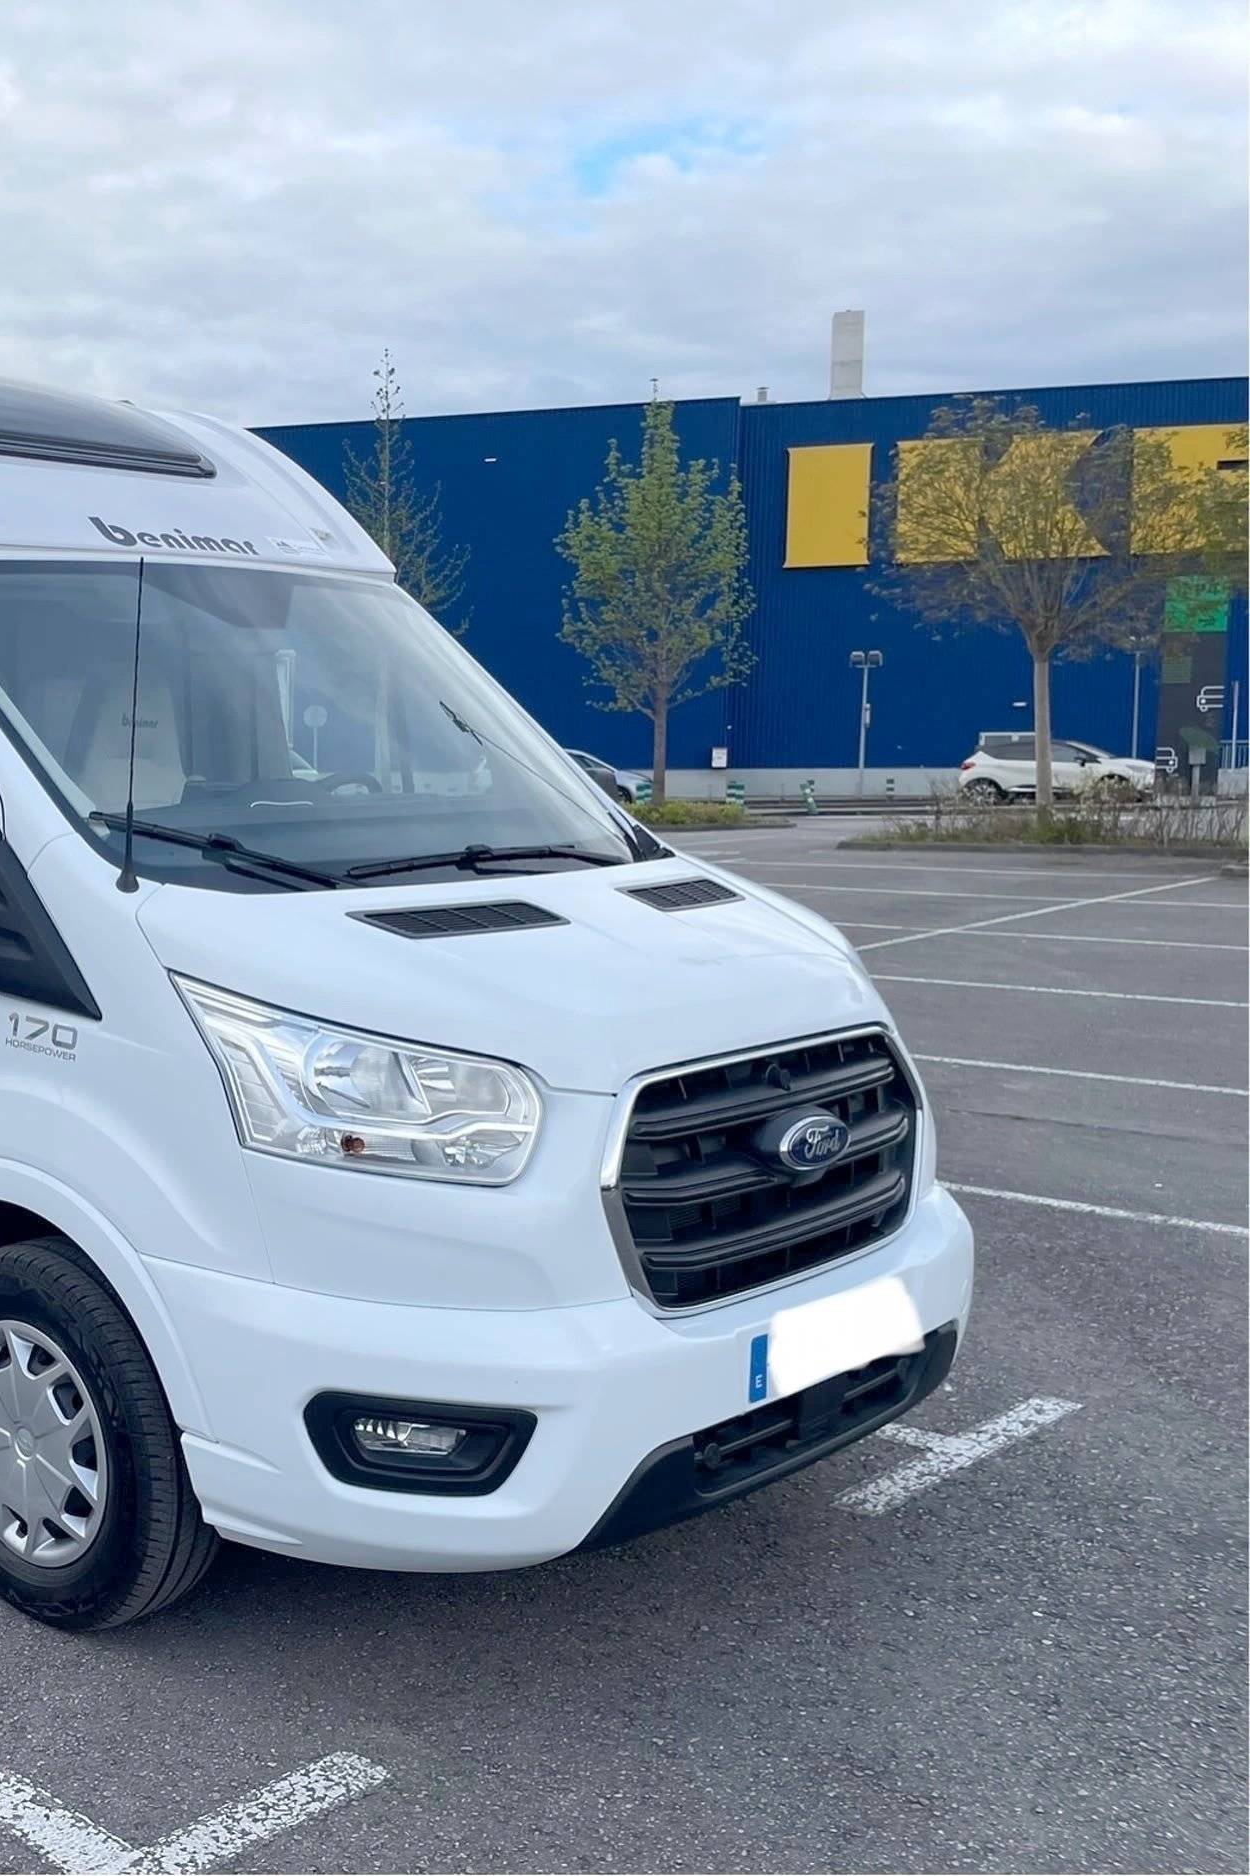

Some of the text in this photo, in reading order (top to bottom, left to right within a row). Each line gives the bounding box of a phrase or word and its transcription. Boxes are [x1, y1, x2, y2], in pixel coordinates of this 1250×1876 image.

[88, 516, 260, 556] benimar
[9, 1012, 78, 1050] 170
[5, 1037, 77, 1062] HORSEPOWER
[804, 1124, 841, 1159] Ford
[755, 1374, 763, 1388] E
